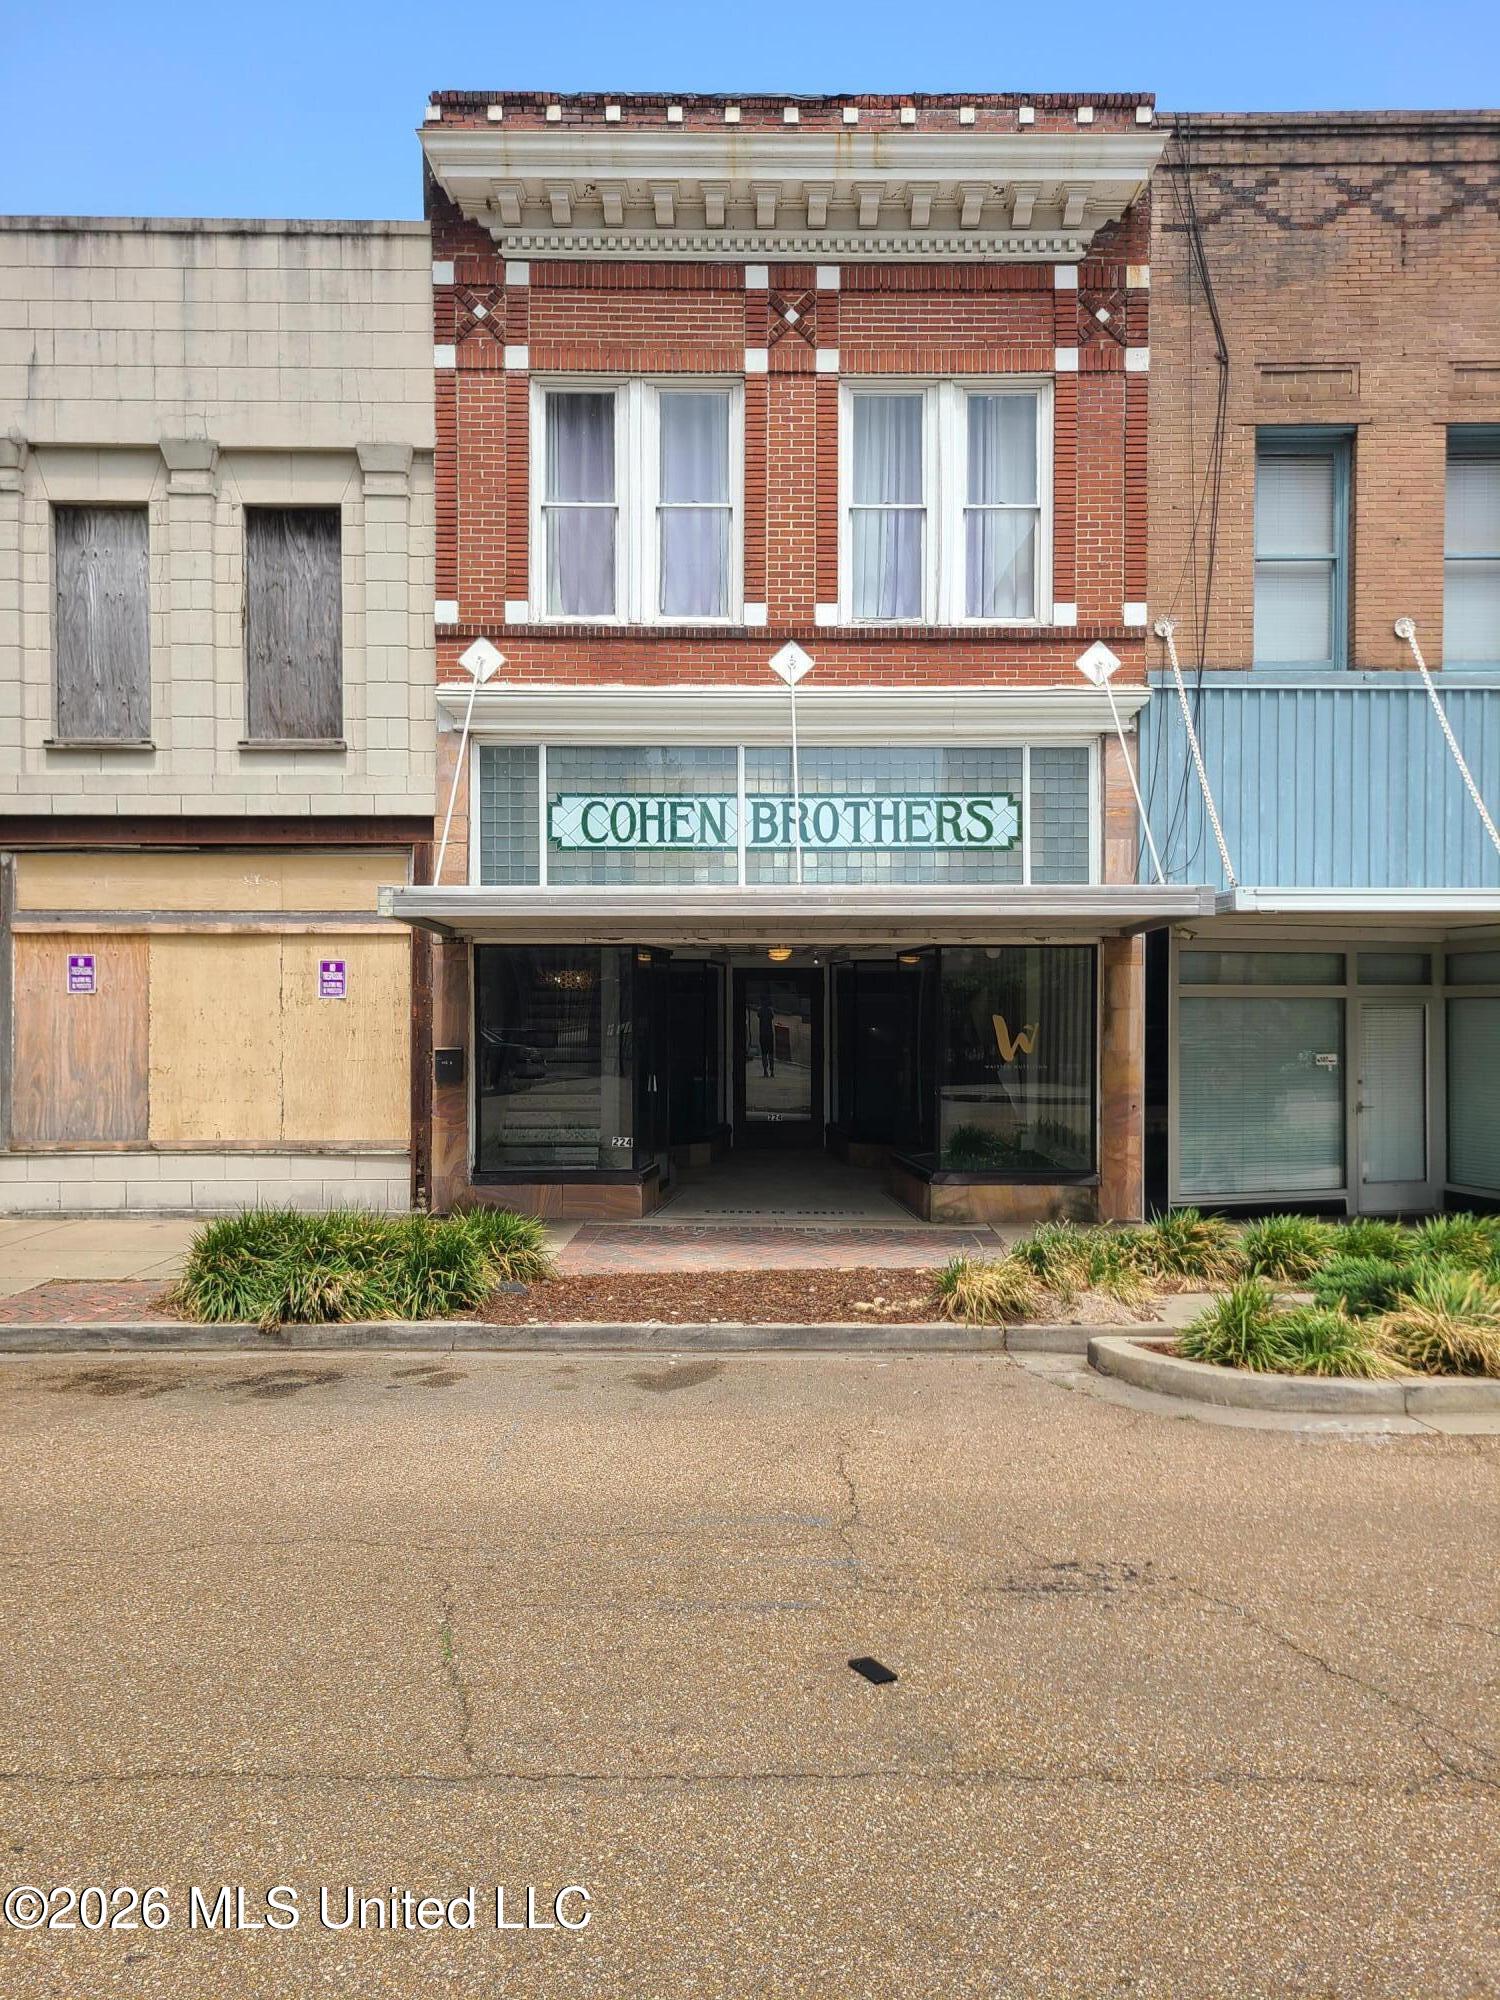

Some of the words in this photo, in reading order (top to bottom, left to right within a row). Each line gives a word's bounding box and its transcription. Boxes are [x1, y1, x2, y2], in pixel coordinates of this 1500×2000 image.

[581, 800, 727, 843] COHEN
[751, 800, 994, 843] BROTHERS
[612, 1136, 632, 1147] 224
